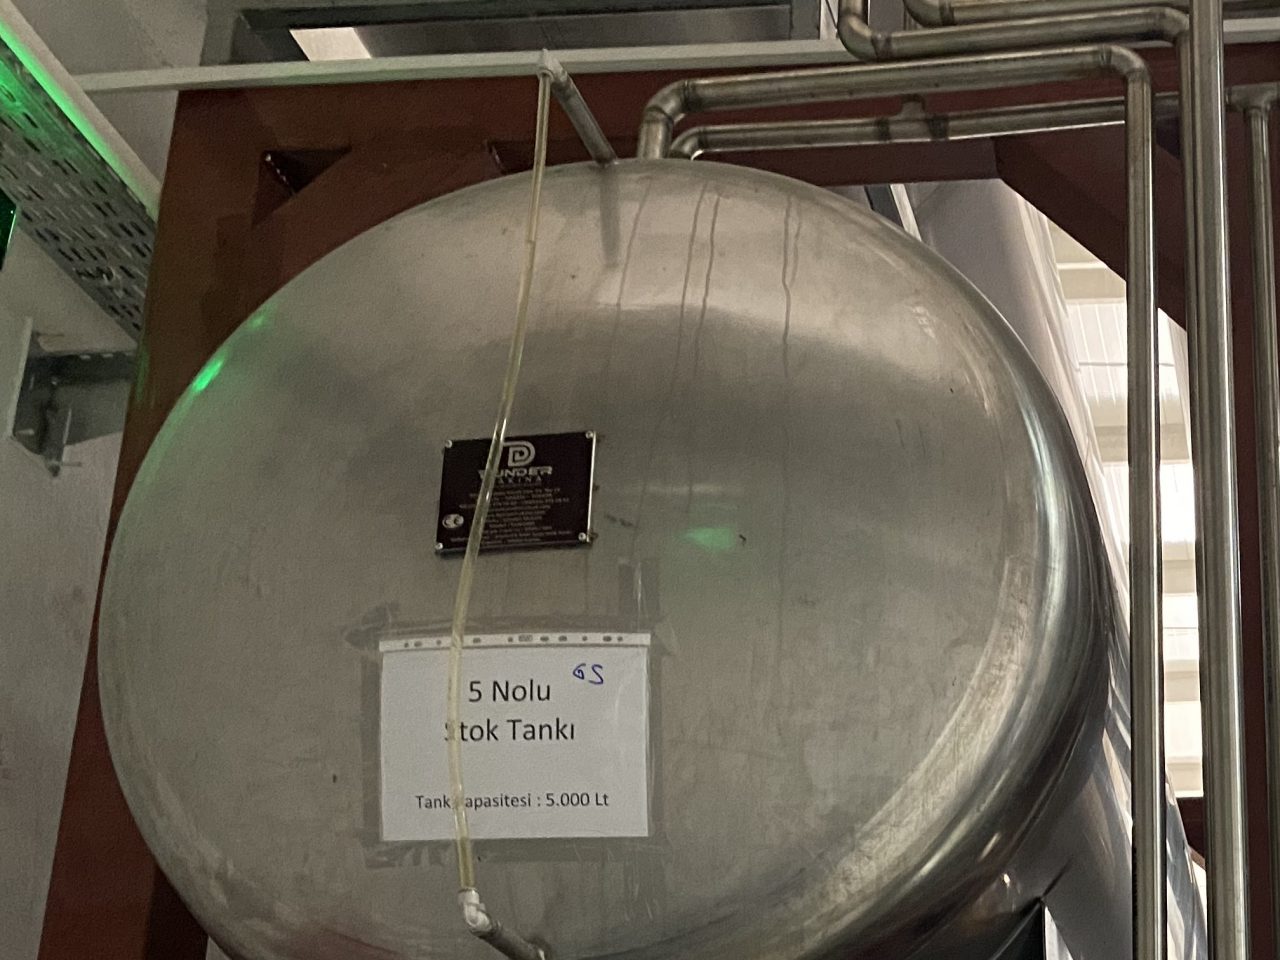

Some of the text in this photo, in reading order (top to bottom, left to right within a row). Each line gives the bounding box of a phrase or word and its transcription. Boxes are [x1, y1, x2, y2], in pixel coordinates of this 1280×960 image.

[468, 679, 551, 702] 5 Nolu
[506, 717, 575, 741] Tankı
[415, 794, 452, 809] Tank
[453, 792, 532, 814] apasitesi
[545, 792, 590, 807] 5.000
[595, 792, 609, 807] Lt
